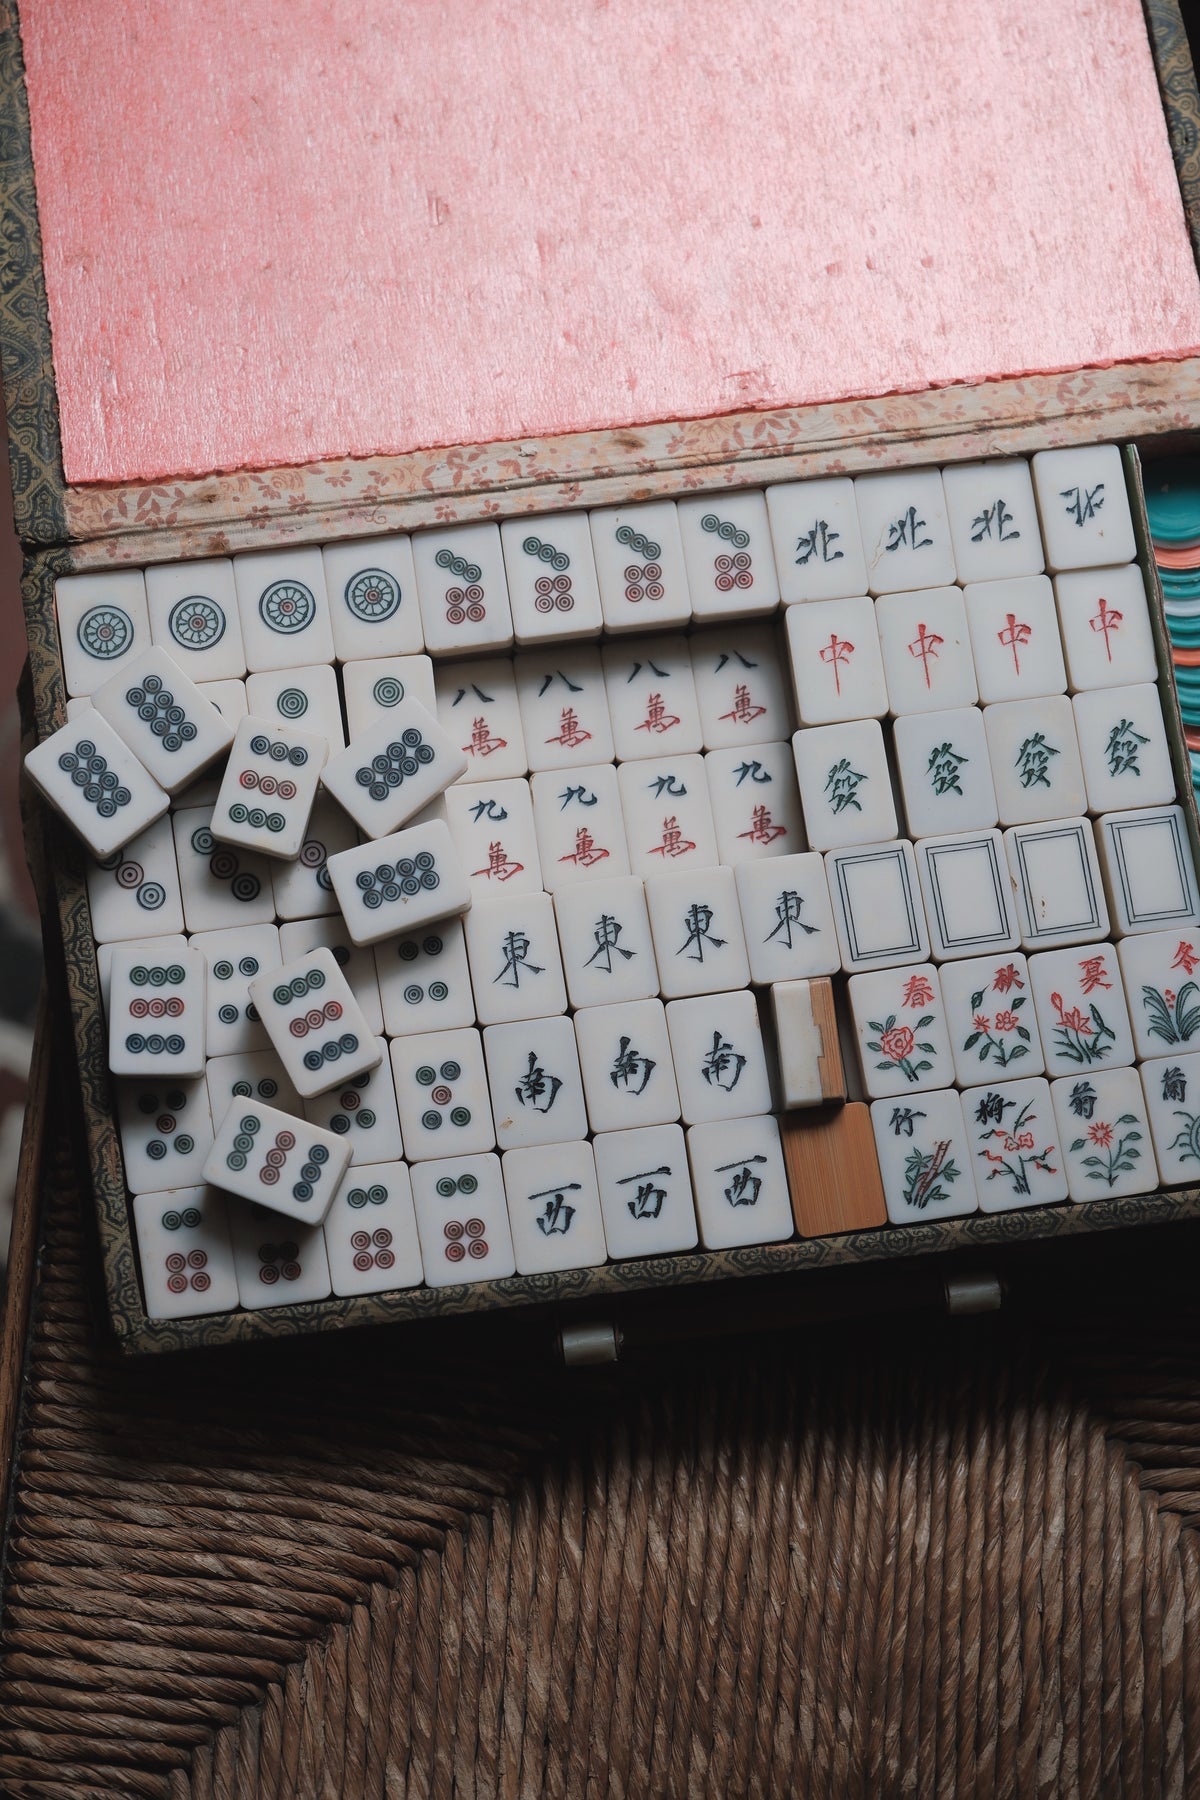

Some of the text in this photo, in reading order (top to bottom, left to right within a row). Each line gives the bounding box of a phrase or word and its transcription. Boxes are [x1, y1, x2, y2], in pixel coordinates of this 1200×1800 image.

[885, 504, 934, 553] 北
[970, 496, 1021, 544] 北
[1058, 482, 1106, 528] 北
[795, 517, 845, 566] 北
[906, 622, 946, 690] 中
[996, 612, 1033, 678] 中
[1087, 596, 1124, 665] 中
[818, 632, 856, 697] 中
[925, 741, 969, 797] 發
[1013, 731, 1062, 789] 發
[1103, 717, 1152, 779] 發
[822, 756, 870, 815] 發
[583, 914, 638, 974] 東
[676, 903, 729, 963] 東
[763, 890, 821, 949] 東
[493, 931, 546, 989] 東
[992, 963, 1025, 994] 秋
[1078, 955, 1114, 995] 夏
[1170, 940, 1200, 975] 冬
[901, 975, 935, 1009] 春
[514, 1050, 564, 1114] 南
[609, 1035, 657, 1096] 南
[701, 1030, 747, 1092] 南
[889, 1107, 927, 1138] 竹
[975, 1090, 1016, 1125] 梅
[527, 1182, 583, 1236] 西
[615, 1165, 672, 1220] 西
[713, 1154, 768, 1208] 西
